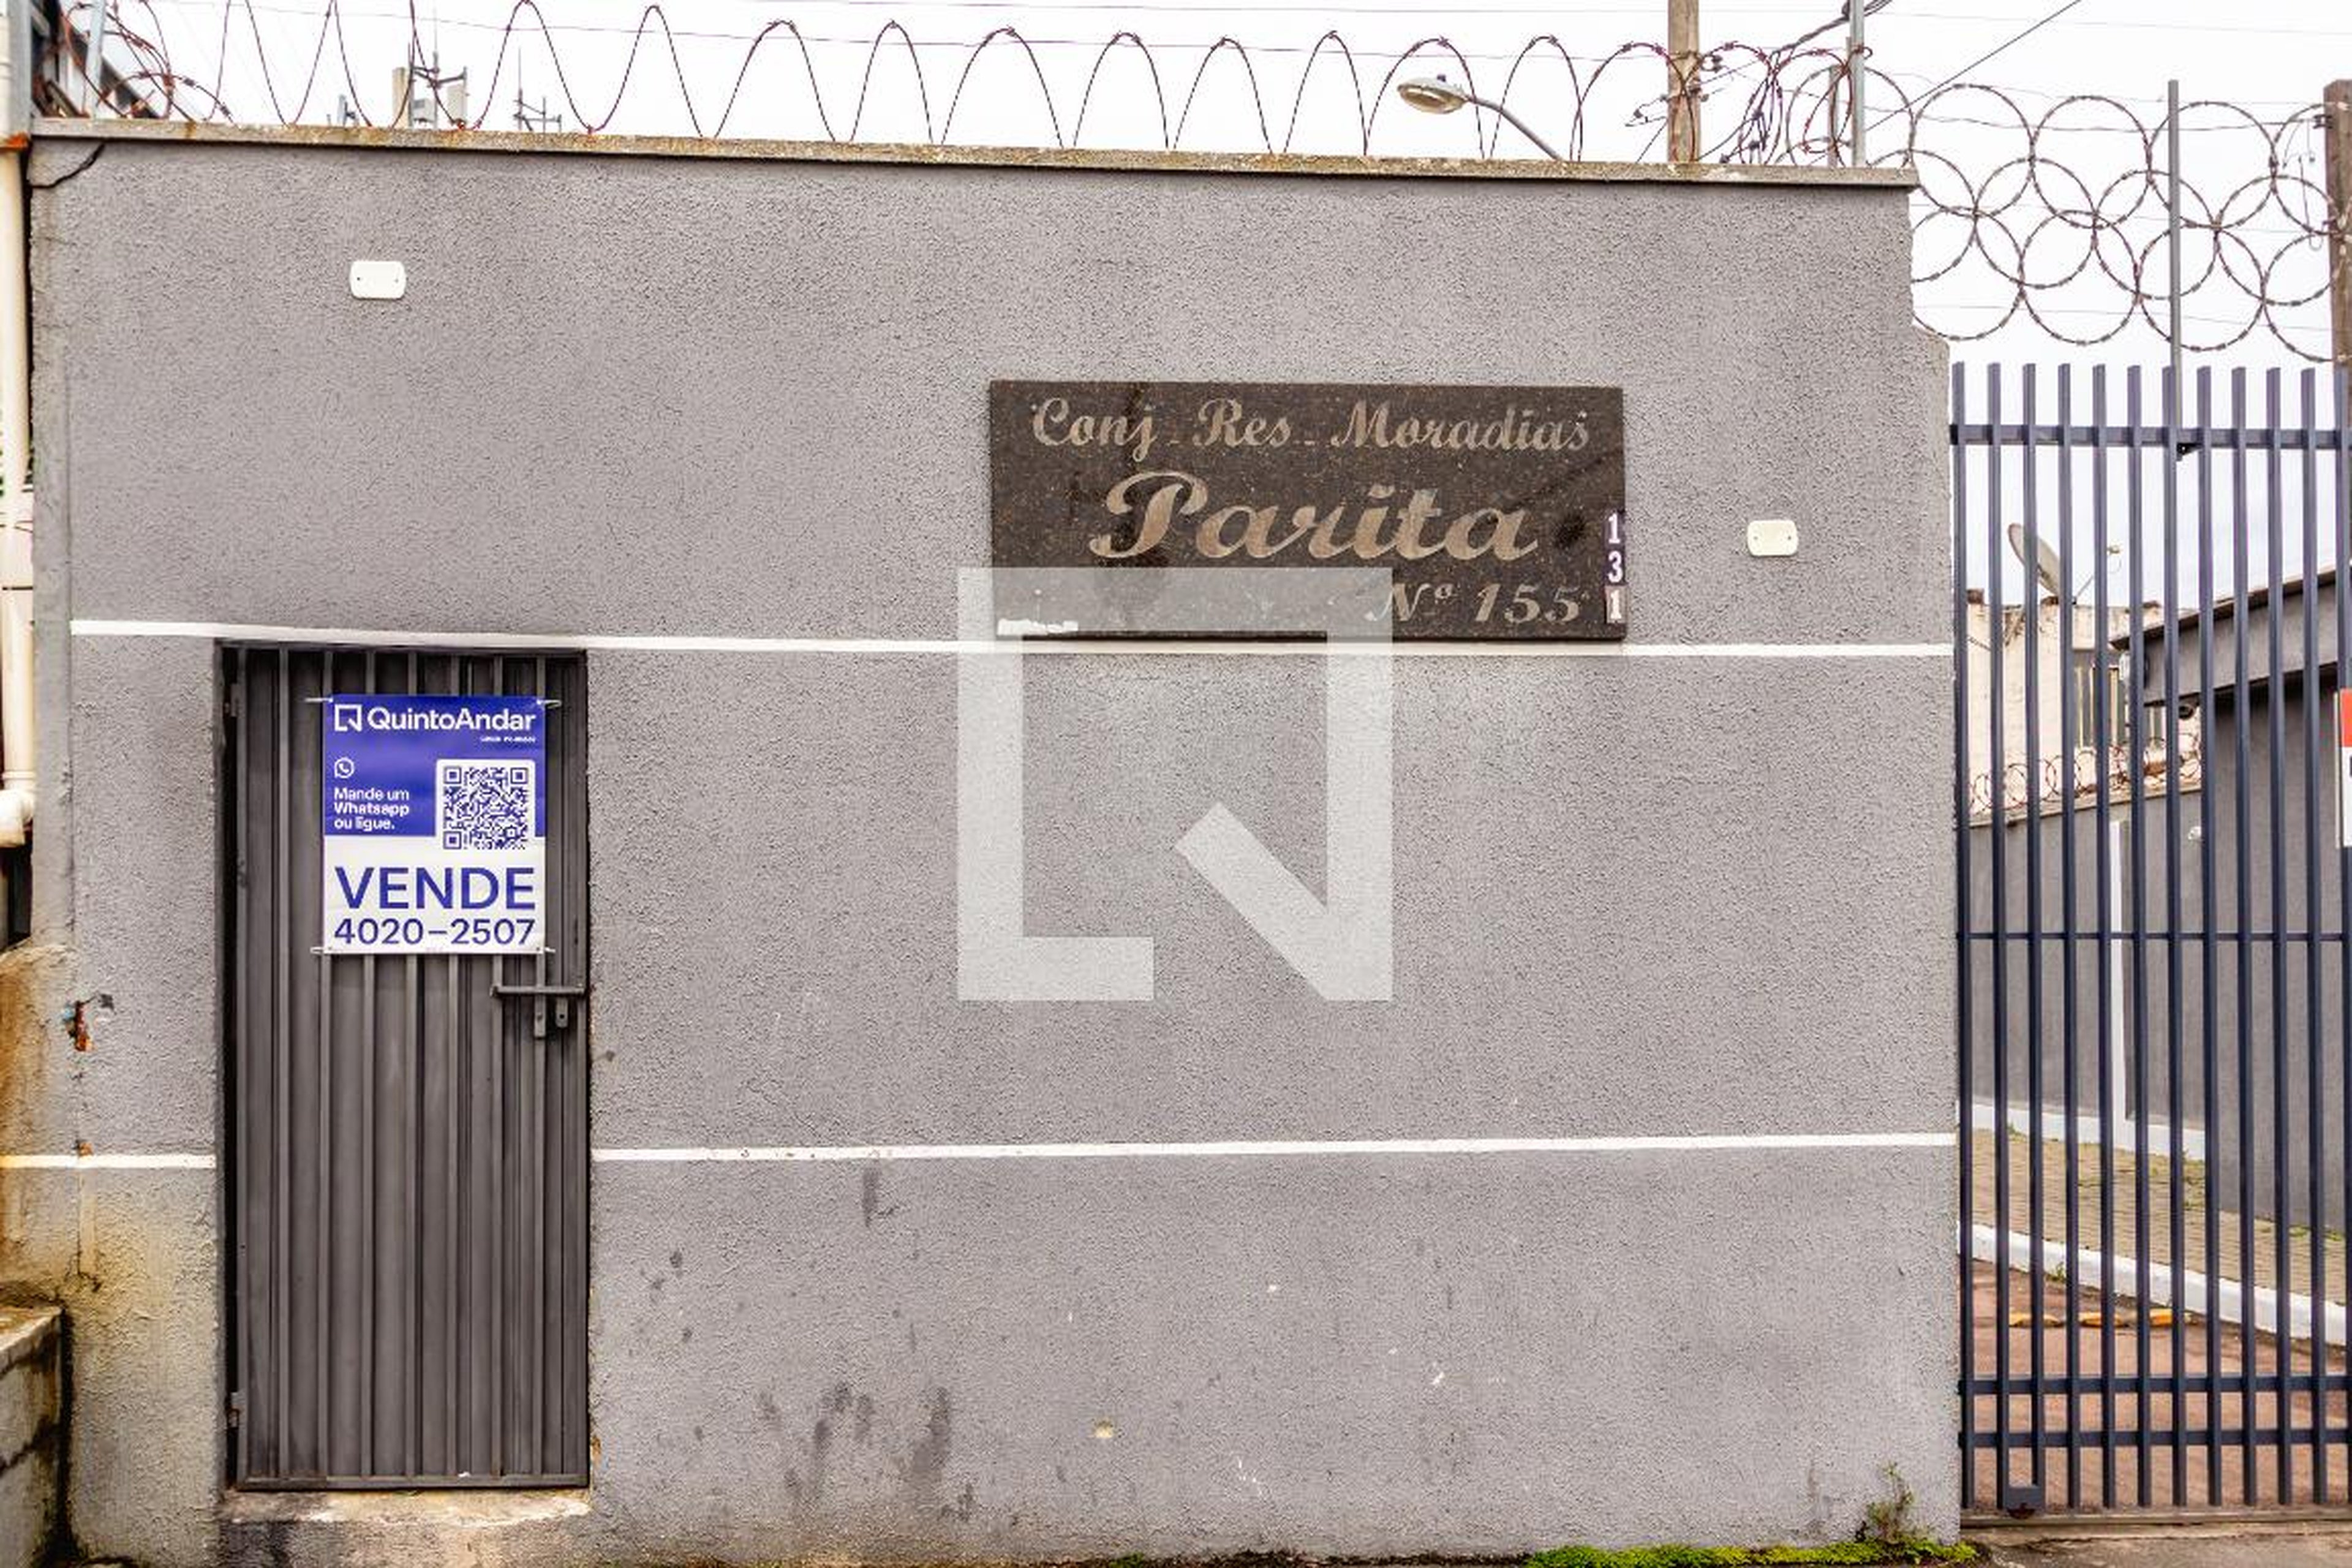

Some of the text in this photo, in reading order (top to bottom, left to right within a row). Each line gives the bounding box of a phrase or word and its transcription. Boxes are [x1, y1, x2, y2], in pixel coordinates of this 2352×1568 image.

[1330, 399, 1591, 451] Moradias
[1089, 470, 1539, 561] Parita
[1473, 582, 1580, 623] 155
[368, 706, 536, 731] QuintoAndar
[334, 787, 410, 801] Mande um
[334, 802, 410, 817] Whatsapp
[334, 816, 395, 832] ou ligue.
[334, 867, 536, 910] VENDE
[334, 918, 535, 945] 4020-2507
